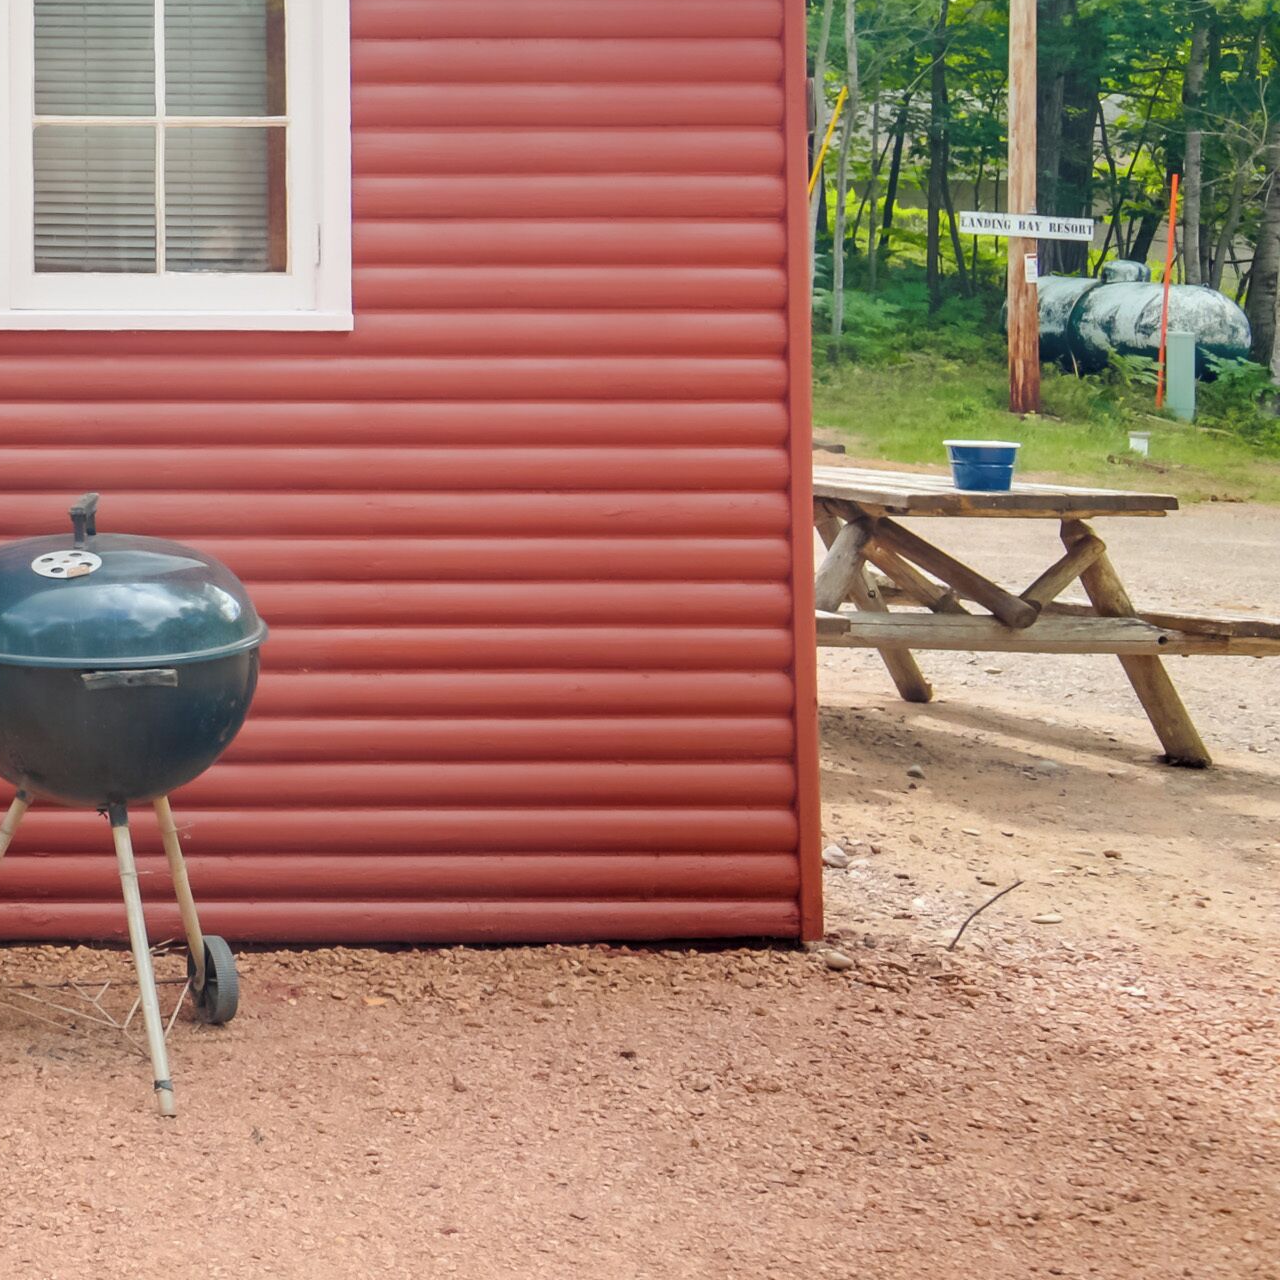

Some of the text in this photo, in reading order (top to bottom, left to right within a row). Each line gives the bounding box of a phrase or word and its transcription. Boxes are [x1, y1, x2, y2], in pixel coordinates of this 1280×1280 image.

[961, 216, 1093, 235] LANDING BAY RESORT
